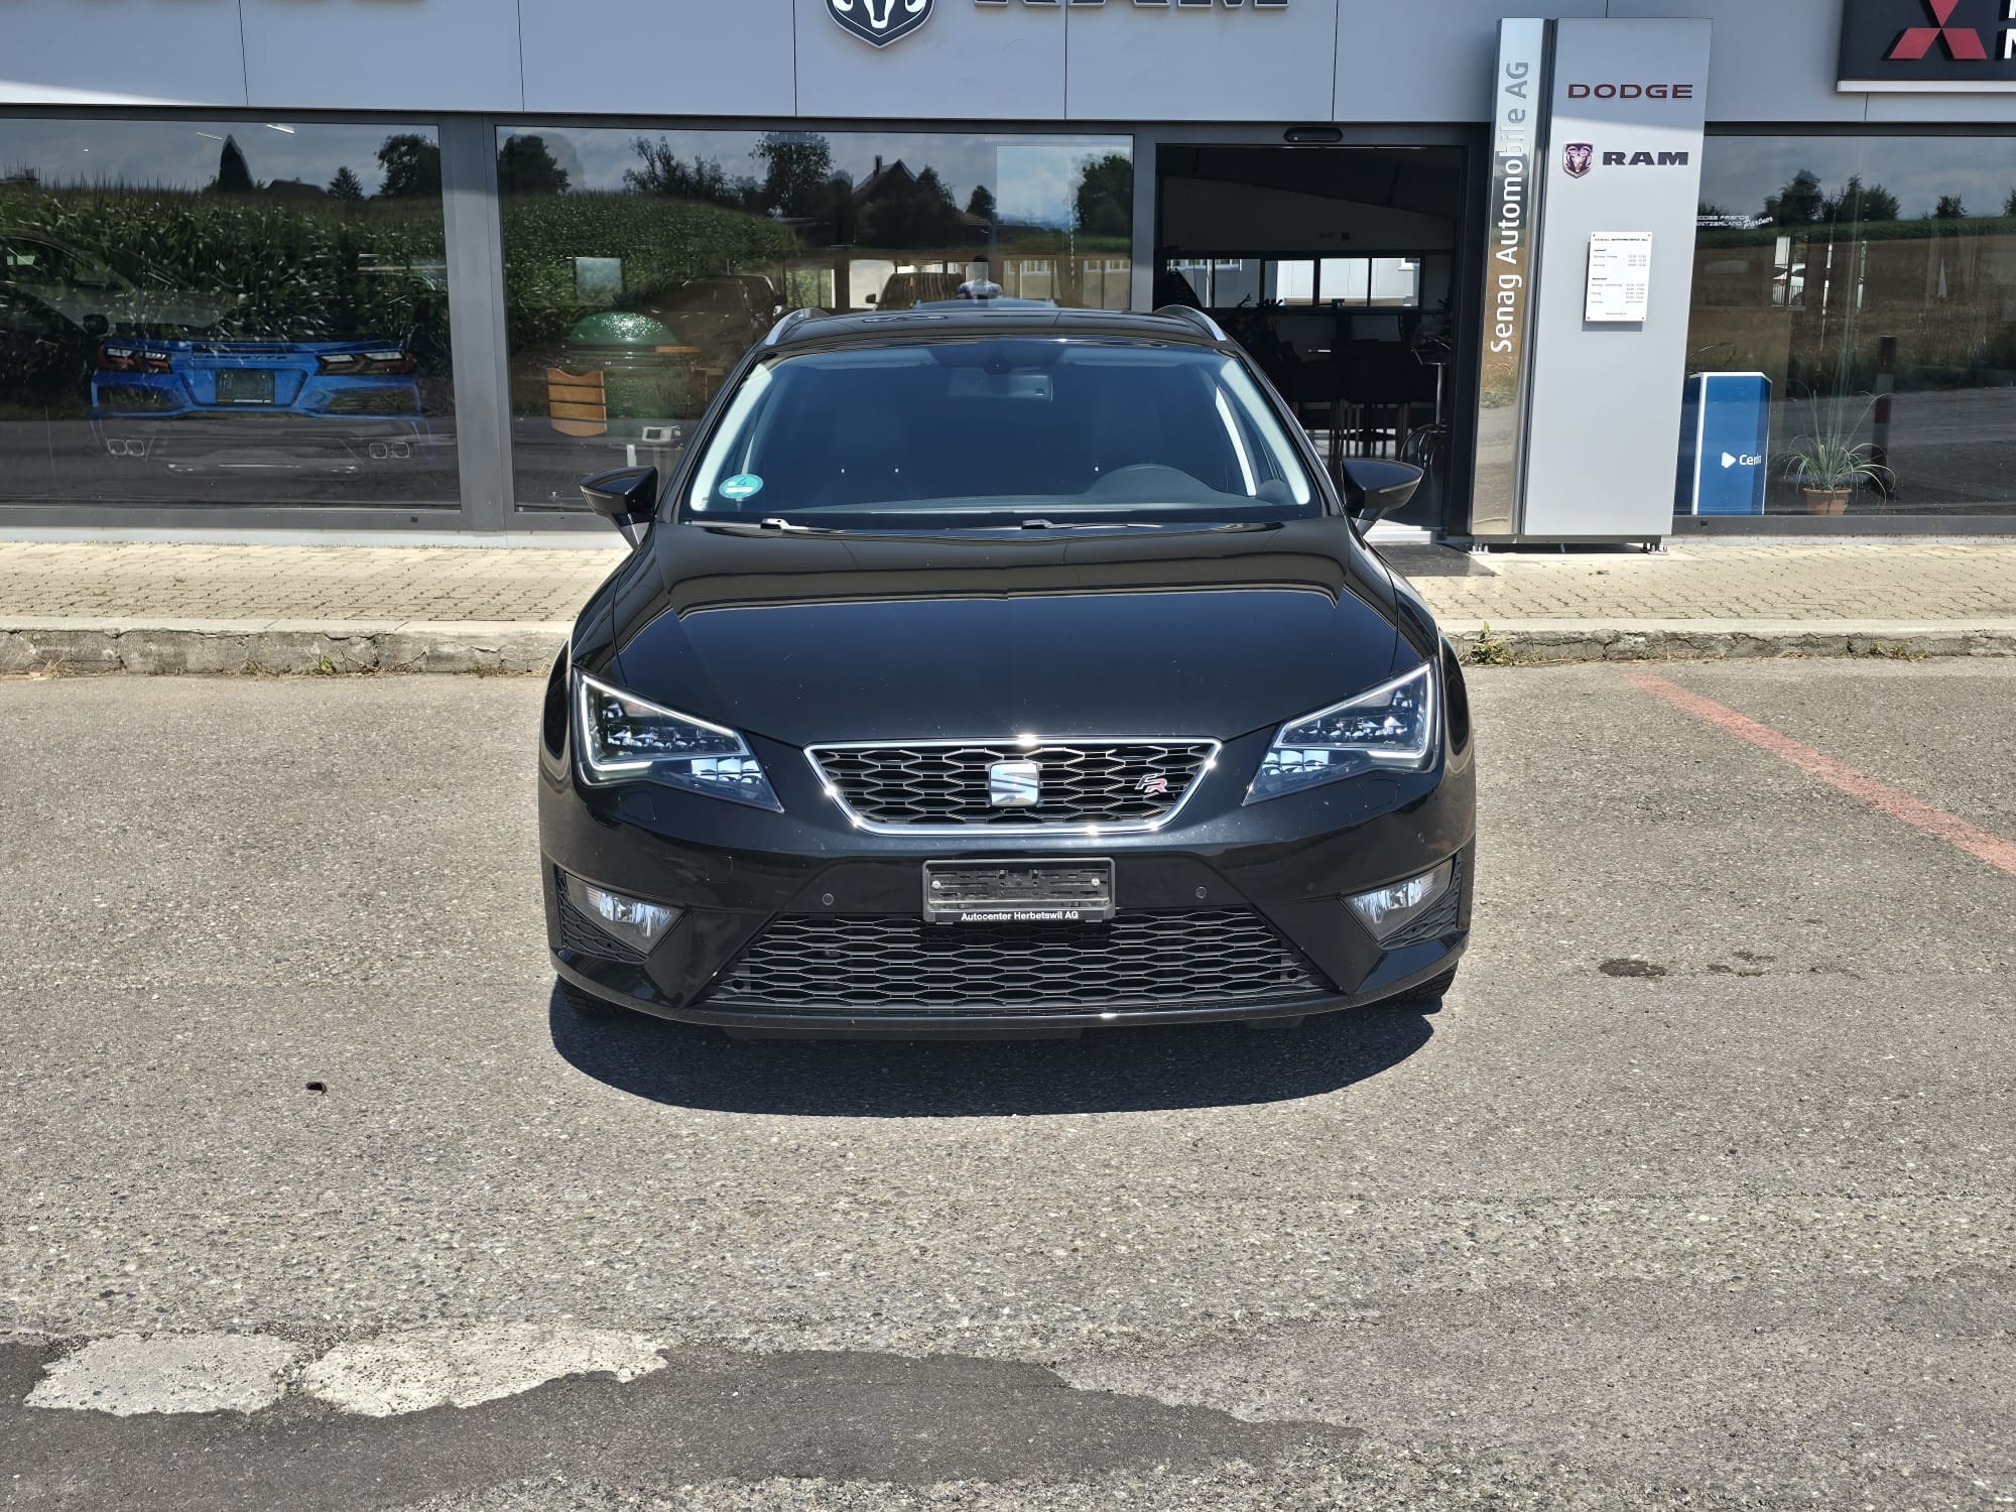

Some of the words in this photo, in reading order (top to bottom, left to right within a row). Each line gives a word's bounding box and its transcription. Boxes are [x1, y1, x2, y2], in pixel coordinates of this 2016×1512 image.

[1504, 62, 1529, 99] AG
[1567, 84, 1693, 99] DODGE
[1602, 151, 1689, 166] RAM
[1496, 108, 1526, 265] Automobile
[1490, 274, 1522, 353] Senag
[1134, 773, 1168, 793] FR
[961, 912, 1012, 921] Autocenter
[1014, 911, 1062, 920] Herbetswil
[1065, 910, 1079, 920] AG
